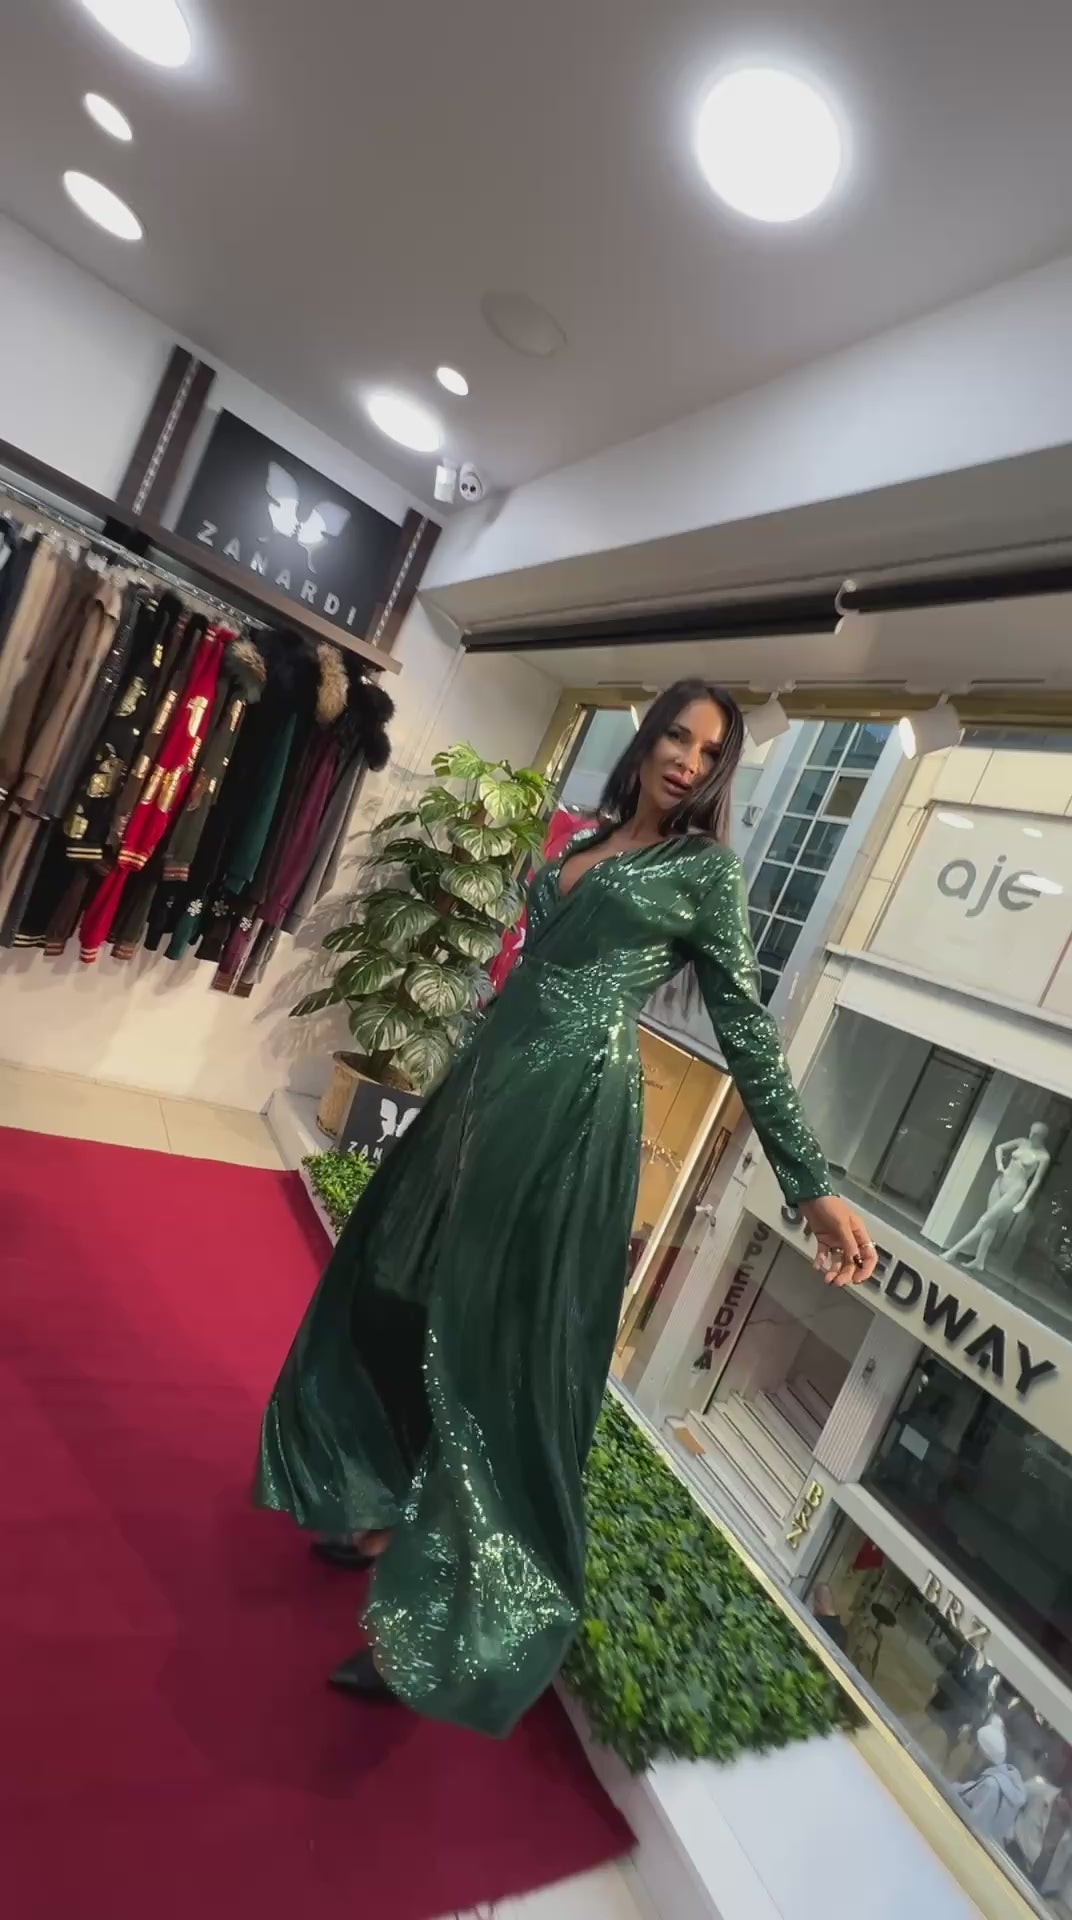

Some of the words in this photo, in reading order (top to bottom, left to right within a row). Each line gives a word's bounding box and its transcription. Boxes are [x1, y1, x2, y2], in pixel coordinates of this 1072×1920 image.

[197, 520, 357, 626] ZANARDI
[937, 854, 1042, 918] aje
[921, 1570, 991, 1651] BRZ
